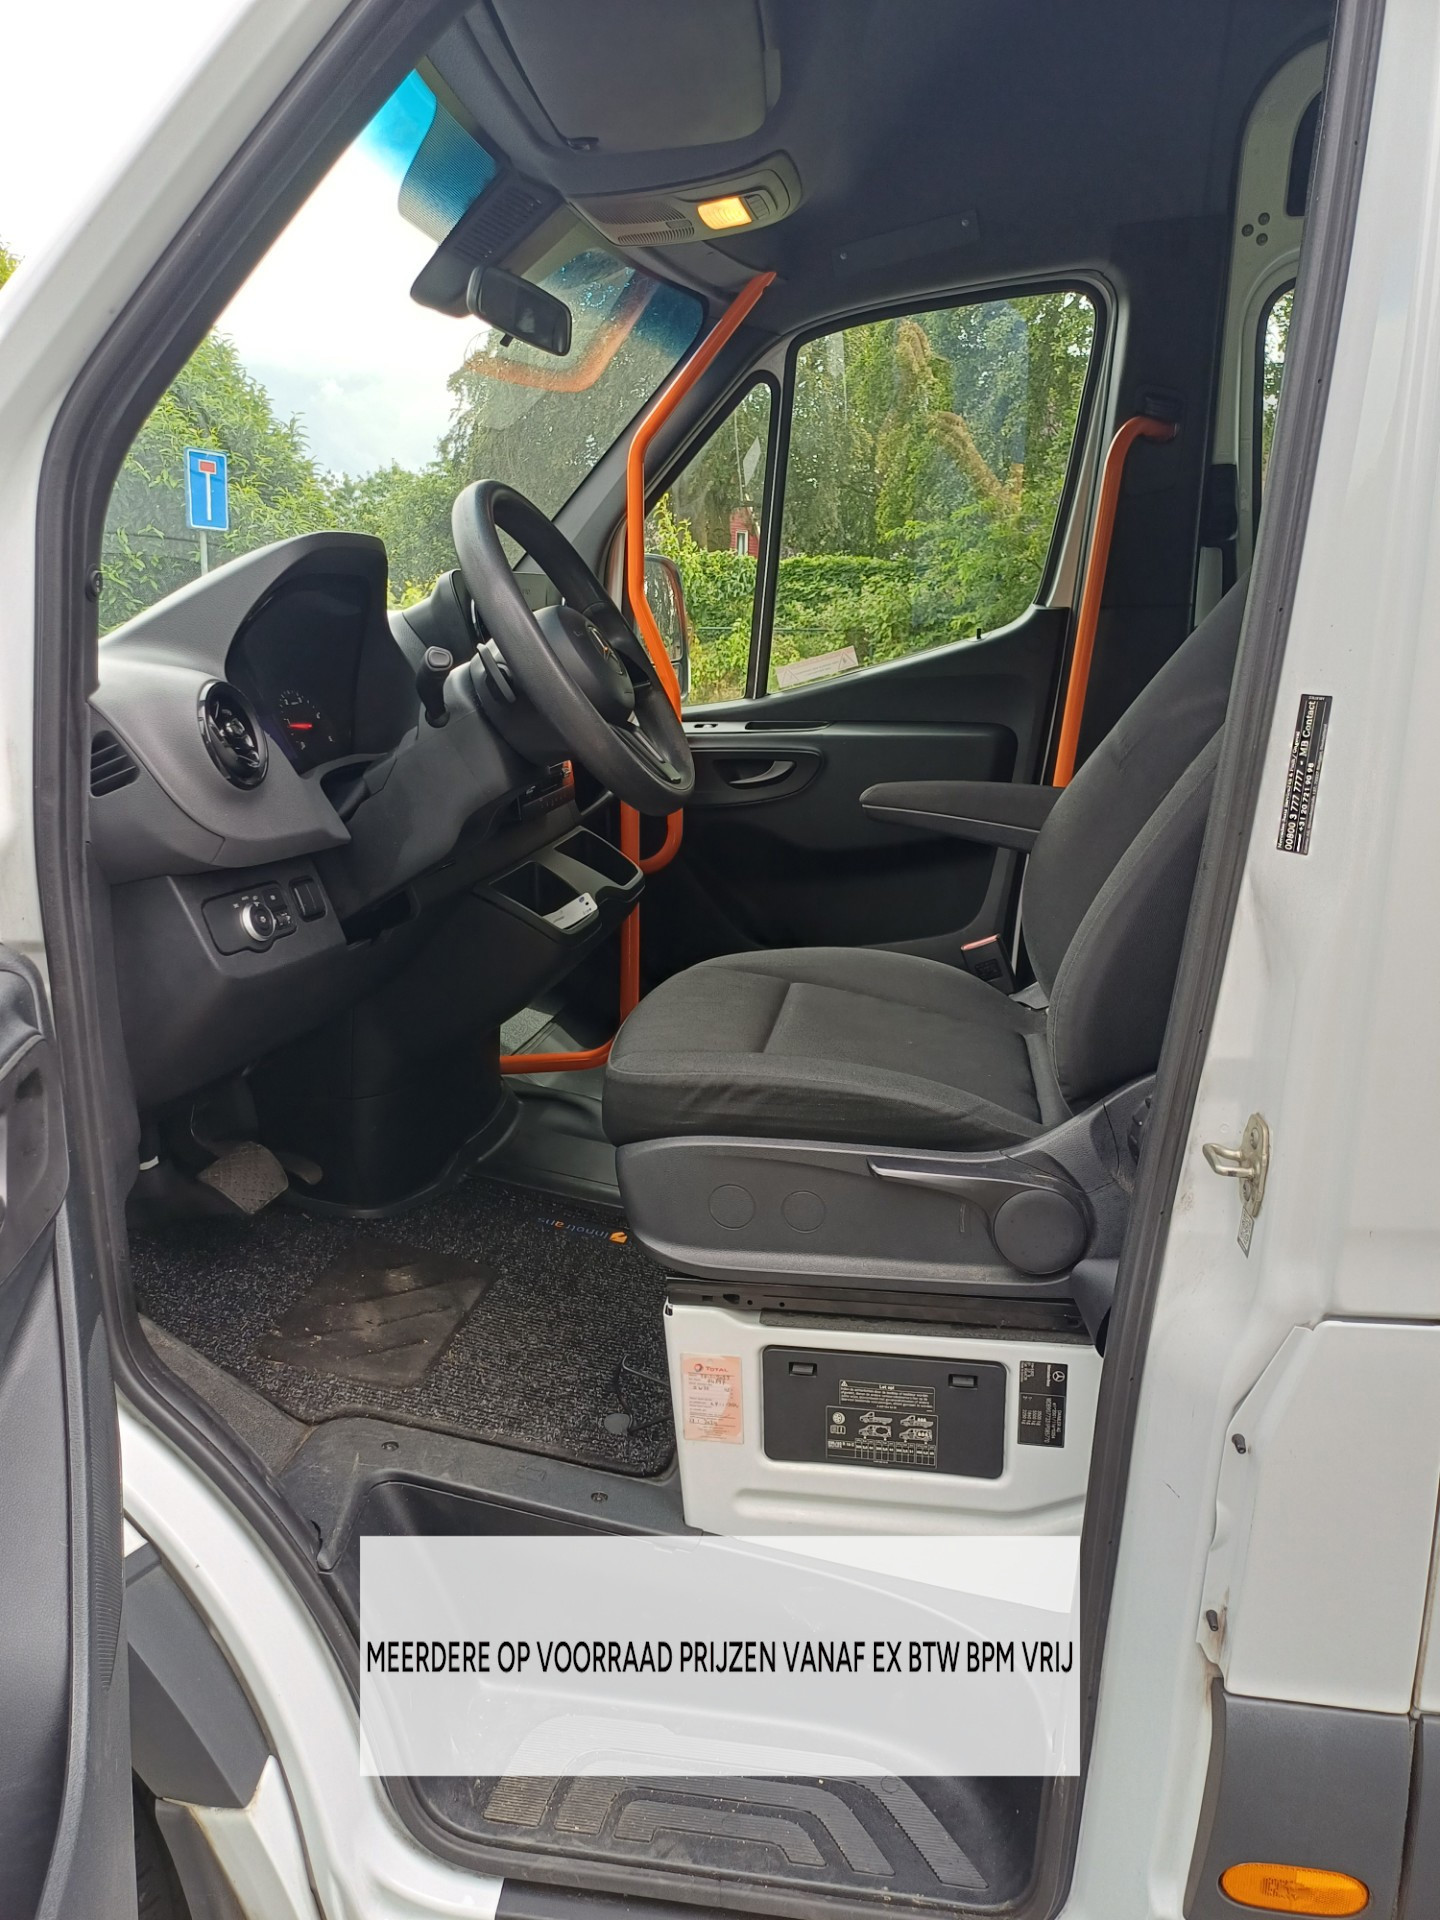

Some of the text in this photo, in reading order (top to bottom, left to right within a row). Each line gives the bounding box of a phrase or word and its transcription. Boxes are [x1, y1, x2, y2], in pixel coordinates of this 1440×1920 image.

[1302, 700, 1316, 738] Contact
[1298, 740, 1309, 757] MB
[1306, 762, 1315, 773] 98
[1293, 769, 1303, 792] 7777
[1304, 775, 1312, 785] 90
[1302, 787, 1310, 802] 721
[1290, 795, 1300, 812] 777
[1300, 804, 1308, 815] 20
[1298, 817, 1306, 832] +31
[1284, 822, 1296, 851] 00800
